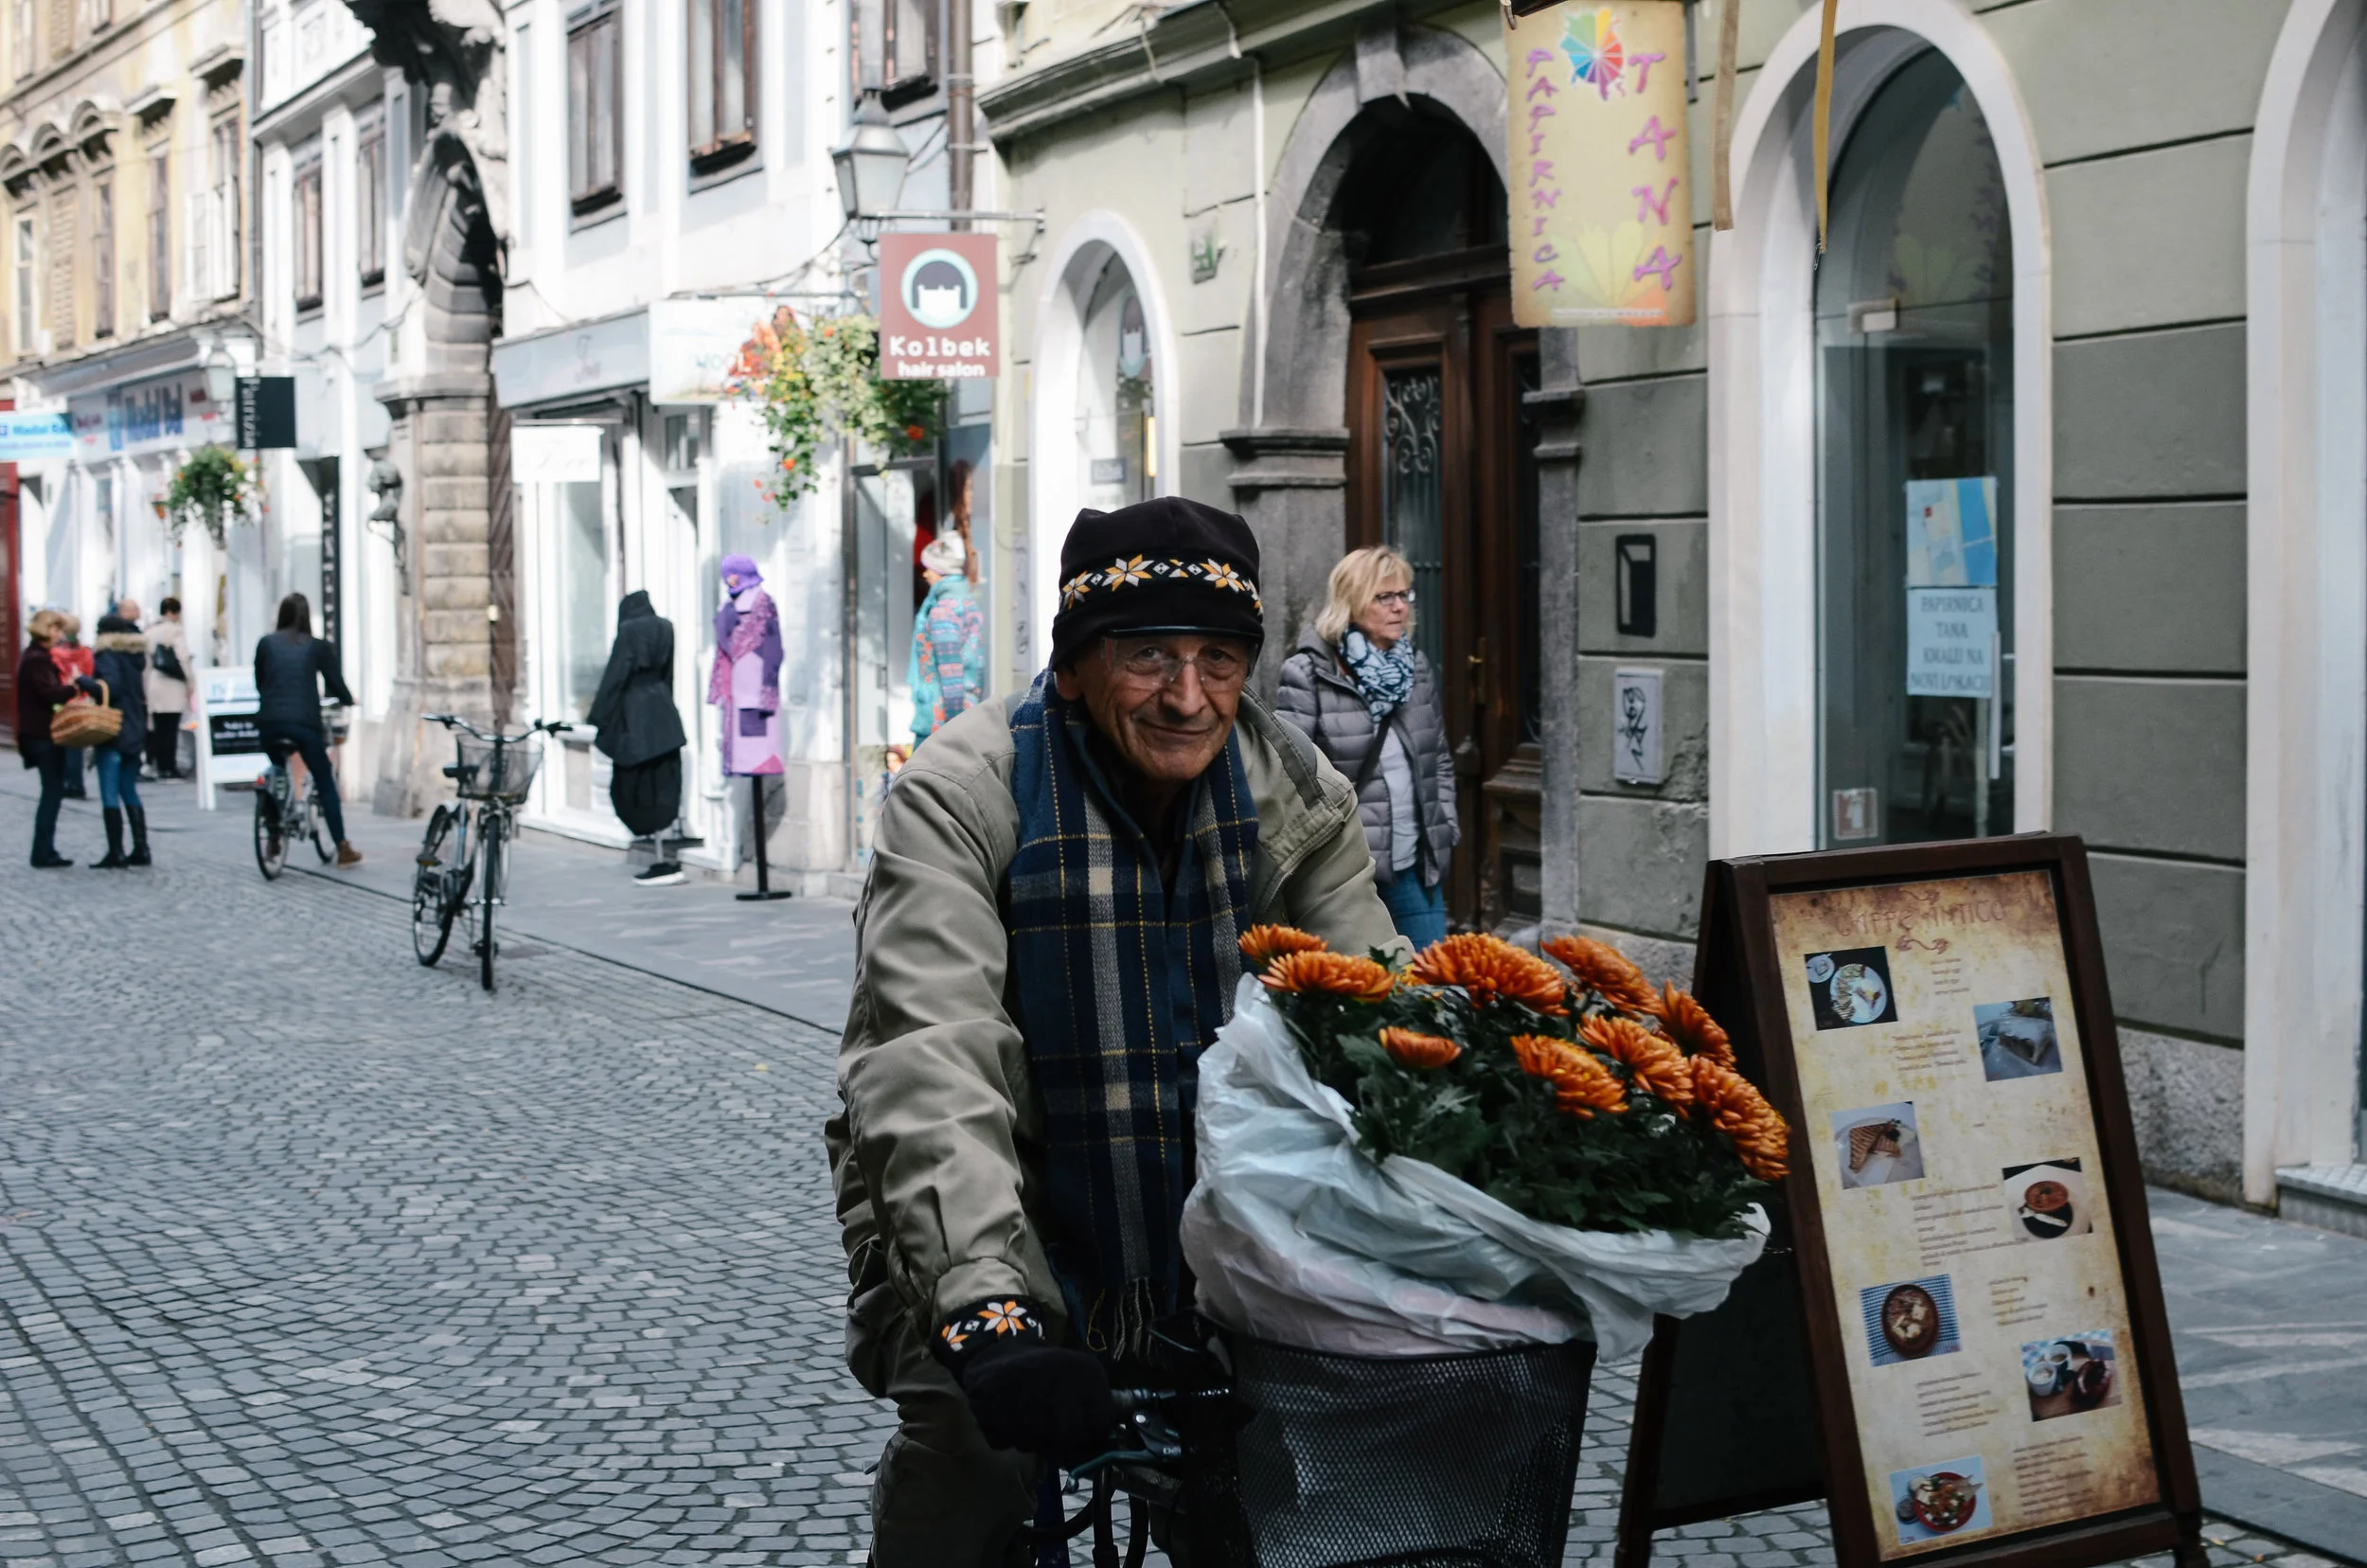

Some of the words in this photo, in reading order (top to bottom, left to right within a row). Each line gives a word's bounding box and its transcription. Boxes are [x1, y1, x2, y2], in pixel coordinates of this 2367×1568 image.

[1526, 48, 1565, 291] PAPIRNICA
[1628, 52, 1682, 291] TANA
[889, 335, 990, 357] Kolbek
[898, 361, 934, 377] hair
[936, 361, 986, 377] salon
